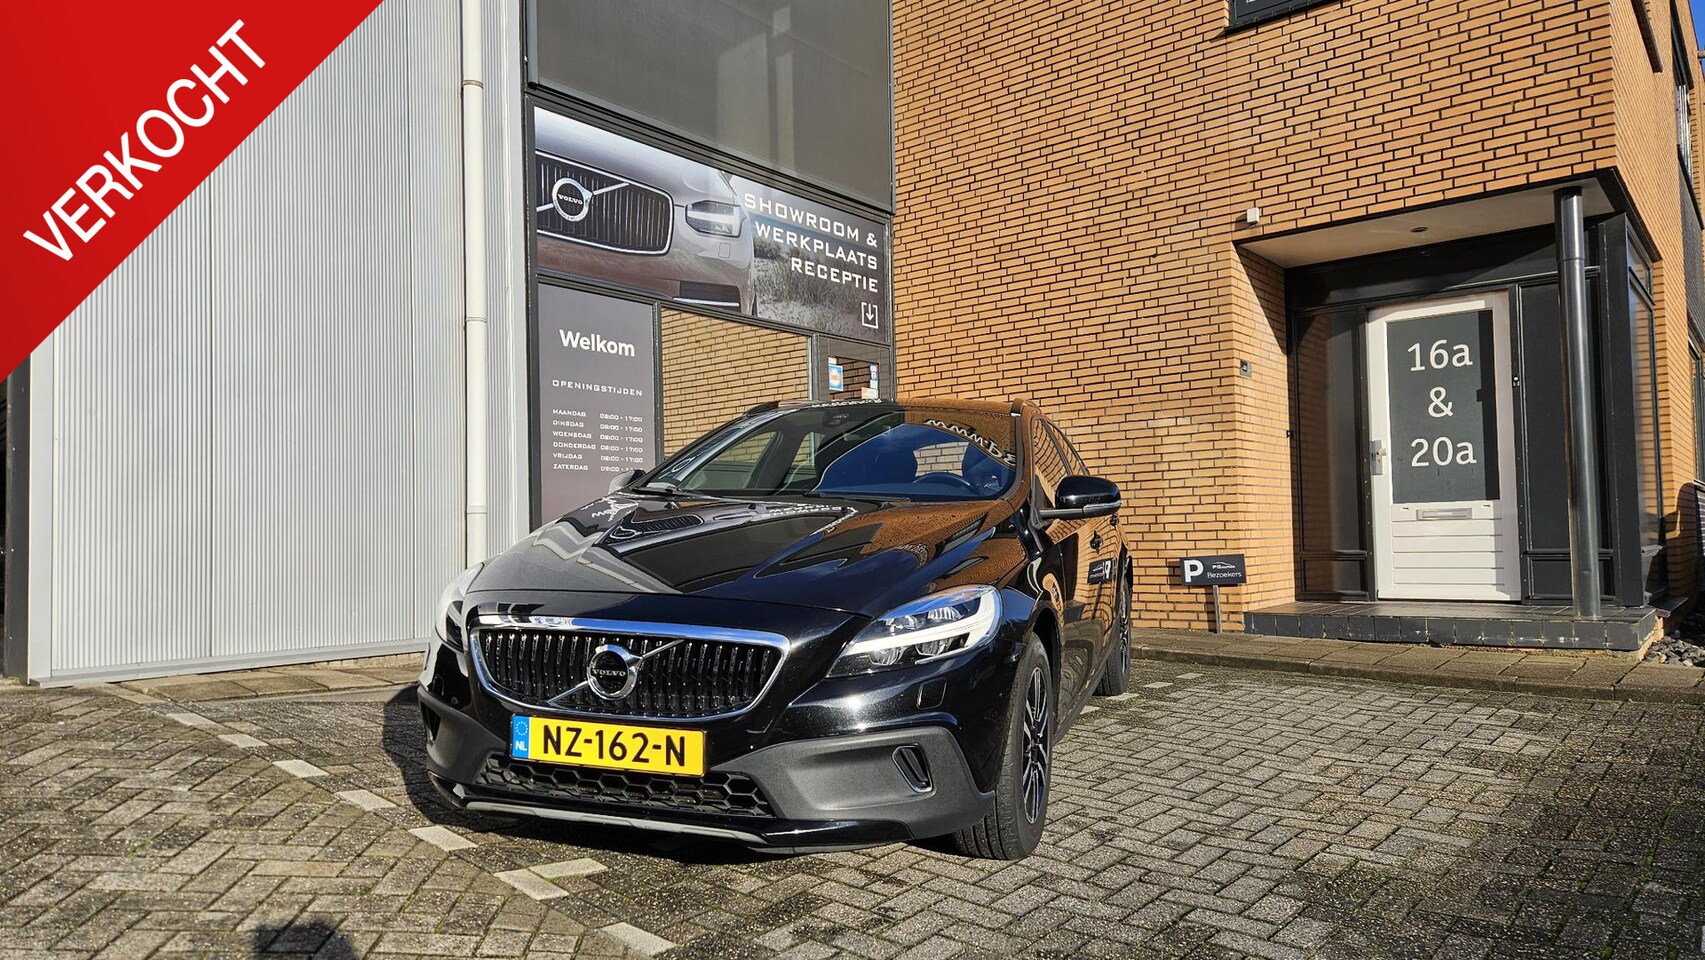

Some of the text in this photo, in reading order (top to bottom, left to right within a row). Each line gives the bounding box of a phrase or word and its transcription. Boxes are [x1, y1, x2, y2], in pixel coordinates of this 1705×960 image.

[557, 193, 583, 205] VOLVO
[744, 193, 877, 248] SHOWROOM &
[755, 221, 877, 270] WERKPLAATS
[791, 257, 878, 293] RECEPTIE
[559, 329, 635, 357] Welkom
[1407, 339, 1473, 371] 16a
[552, 379, 643, 396] OPENINGSTIJDEN
[1428, 386, 1454, 418] &
[552, 409, 587, 417] MAANDAG
[552, 420, 585, 428] DINSDAG
[552, 430, 592, 439] WOENSDAG
[552, 441, 596, 450] DONDERDAG
[1410, 436, 1477, 467] 20a
[552, 452, 583, 460] VRIJDAG
[553, 463, 589, 471] ZATERDAG
[1184, 560, 1204, 582] P
[591, 668, 626, 677] VOLVO
[515, 740, 528, 751] NL
[543, 725, 686, 767] NZ-162-N
